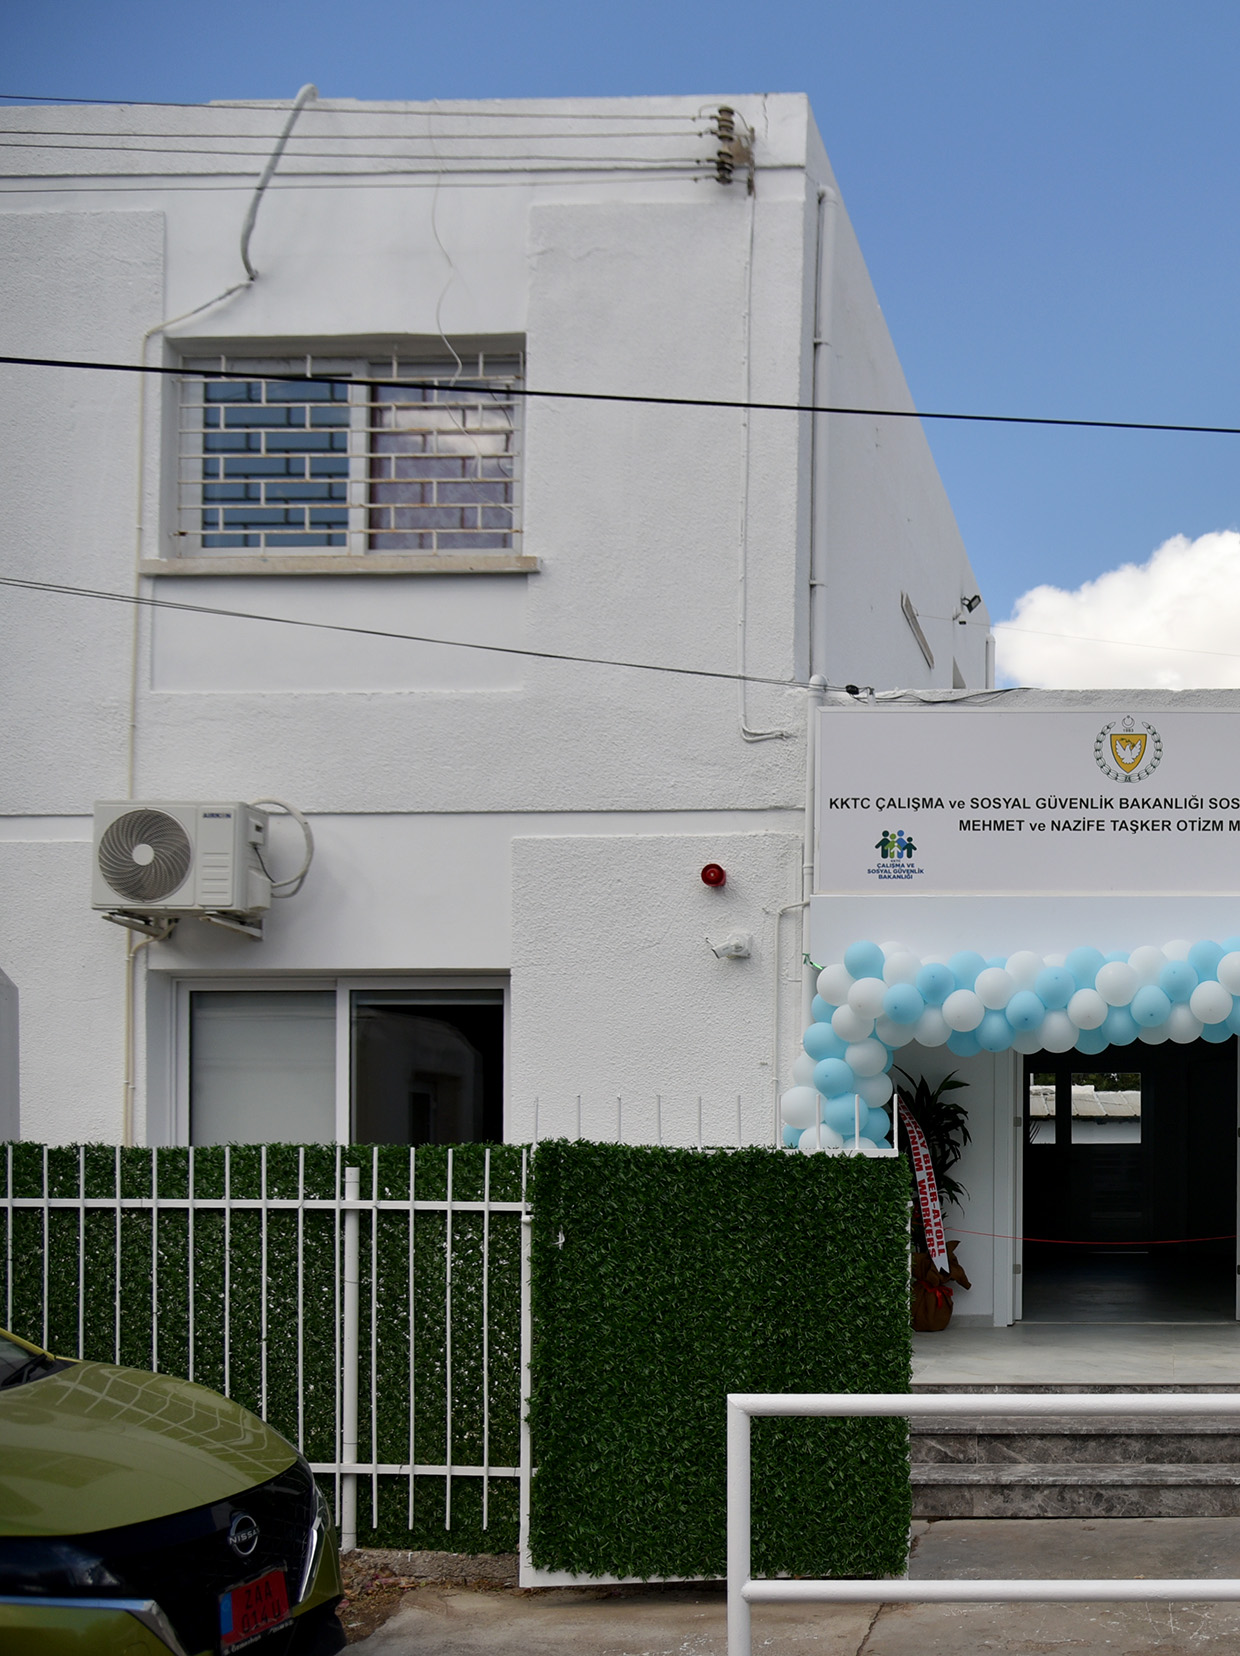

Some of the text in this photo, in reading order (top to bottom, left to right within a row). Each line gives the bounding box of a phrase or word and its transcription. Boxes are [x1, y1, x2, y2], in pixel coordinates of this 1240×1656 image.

[829, 797, 871, 809] KKTC
[875, 797, 945, 812] ÇALIŞMA
[948, 799, 966, 809] ve
[970, 797, 1031, 809] SOSYAL
[1035, 795, 1115, 809] GÜVENLİK
[1119, 795, 1204, 809] BAKANLIĞI
[958, 819, 1025, 831] MEHMET
[1029, 822, 1047, 832] ve
[1050, 817, 1106, 831] NAZİFE
[1110, 819, 1172, 834] TAŞKER
[1176, 817, 1224, 831] OTİZM
[898, 1106, 937, 1259] ATINUM WORKERS
[244, 1580, 273, 1610] ZAA
